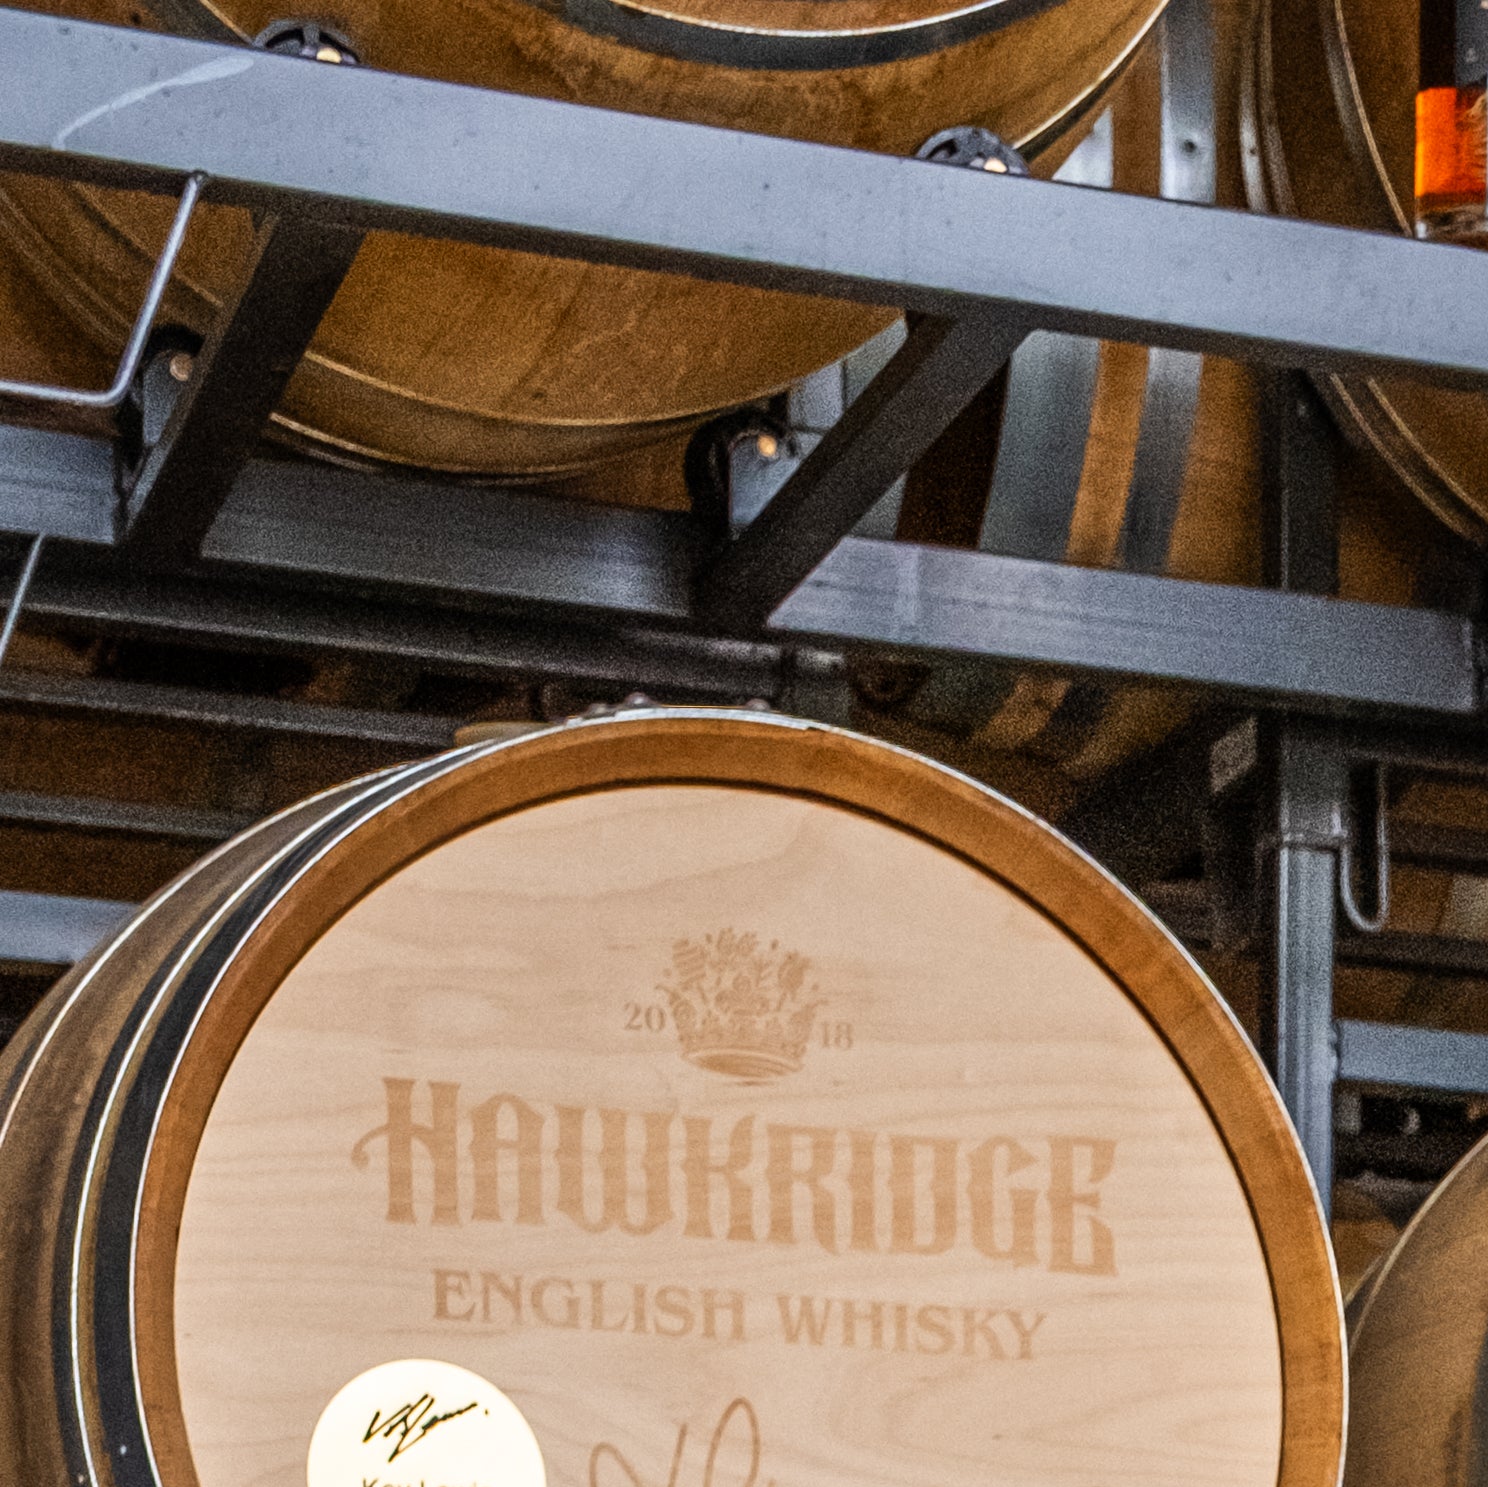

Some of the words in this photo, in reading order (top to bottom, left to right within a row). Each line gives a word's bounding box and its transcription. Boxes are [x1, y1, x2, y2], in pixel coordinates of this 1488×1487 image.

[623, 1001, 666, 1034] 20
[819, 1020, 855, 1051] 18
[350, 1076, 1119, 1277] HAWKRIDGE
[431, 1268, 747, 1342] ENGLISH
[774, 1293, 1048, 1361] WHISKY
